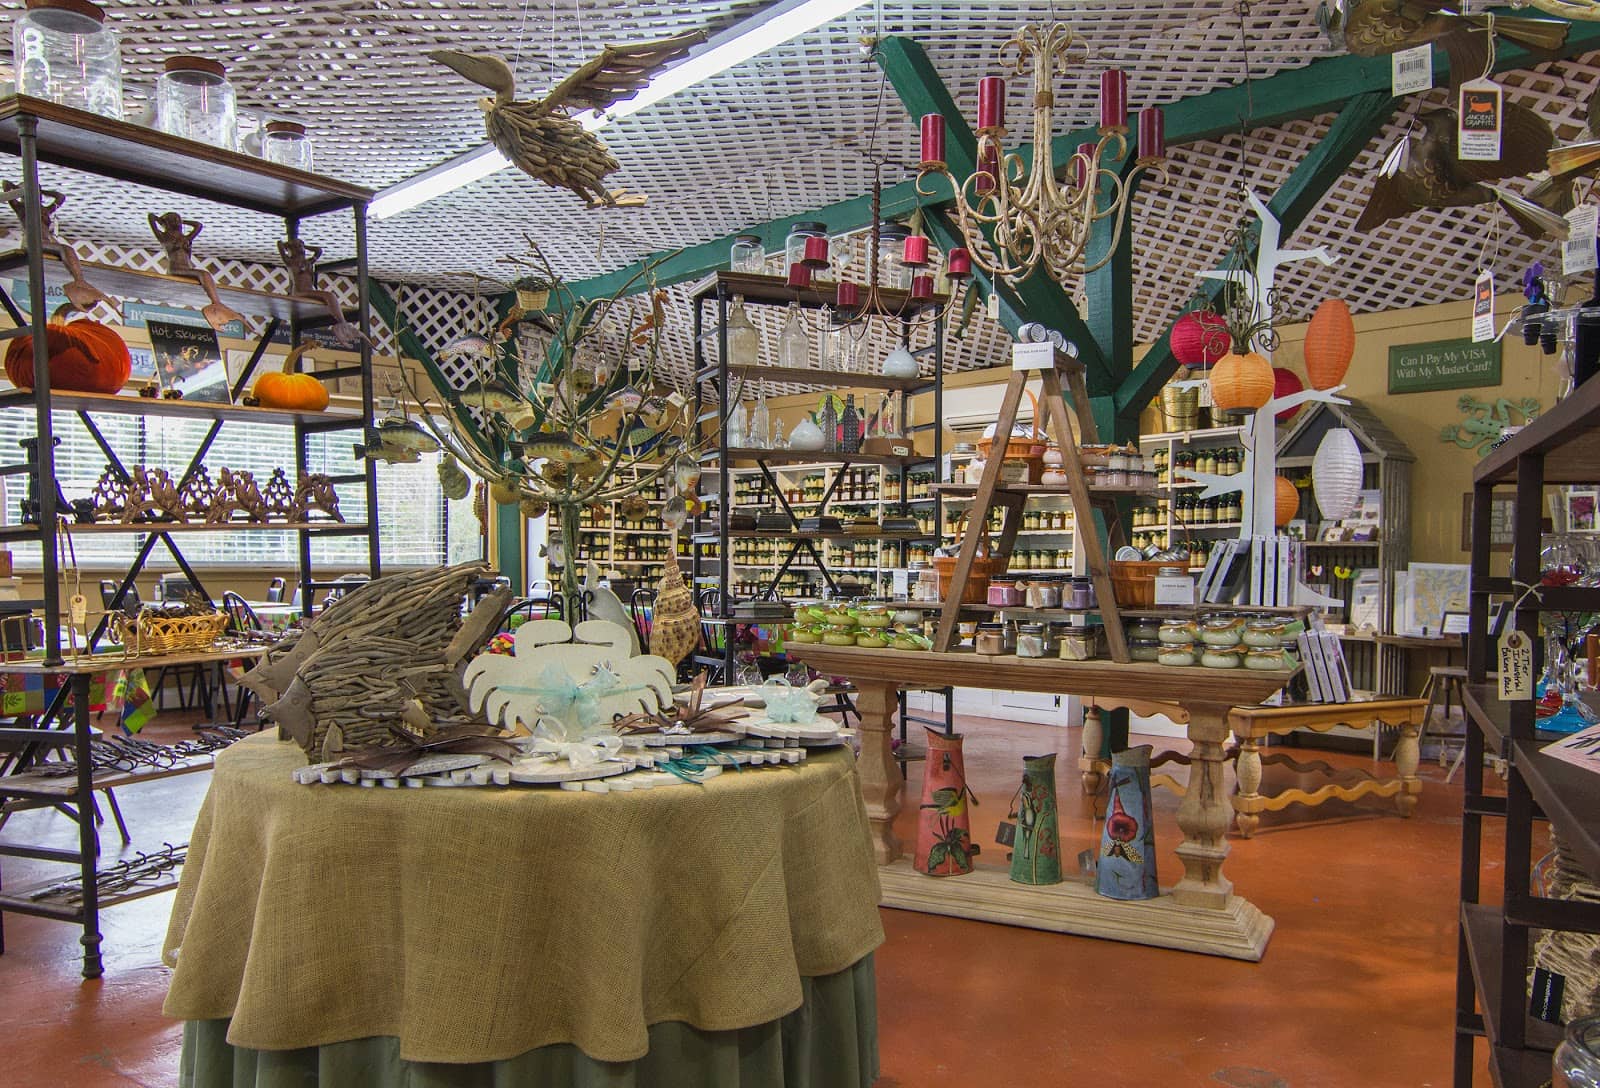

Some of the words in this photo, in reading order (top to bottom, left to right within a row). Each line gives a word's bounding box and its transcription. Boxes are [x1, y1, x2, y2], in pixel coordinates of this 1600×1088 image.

[1400, 356, 1418, 367] Can
[1426, 353, 1441, 365] Pay
[1443, 351, 1458, 363] My
[1461, 348, 1487, 360] VISA
[1396, 369, 1417, 379] With
[1419, 367, 1433, 379] My
[1522, 657, 1530, 677] Tier
